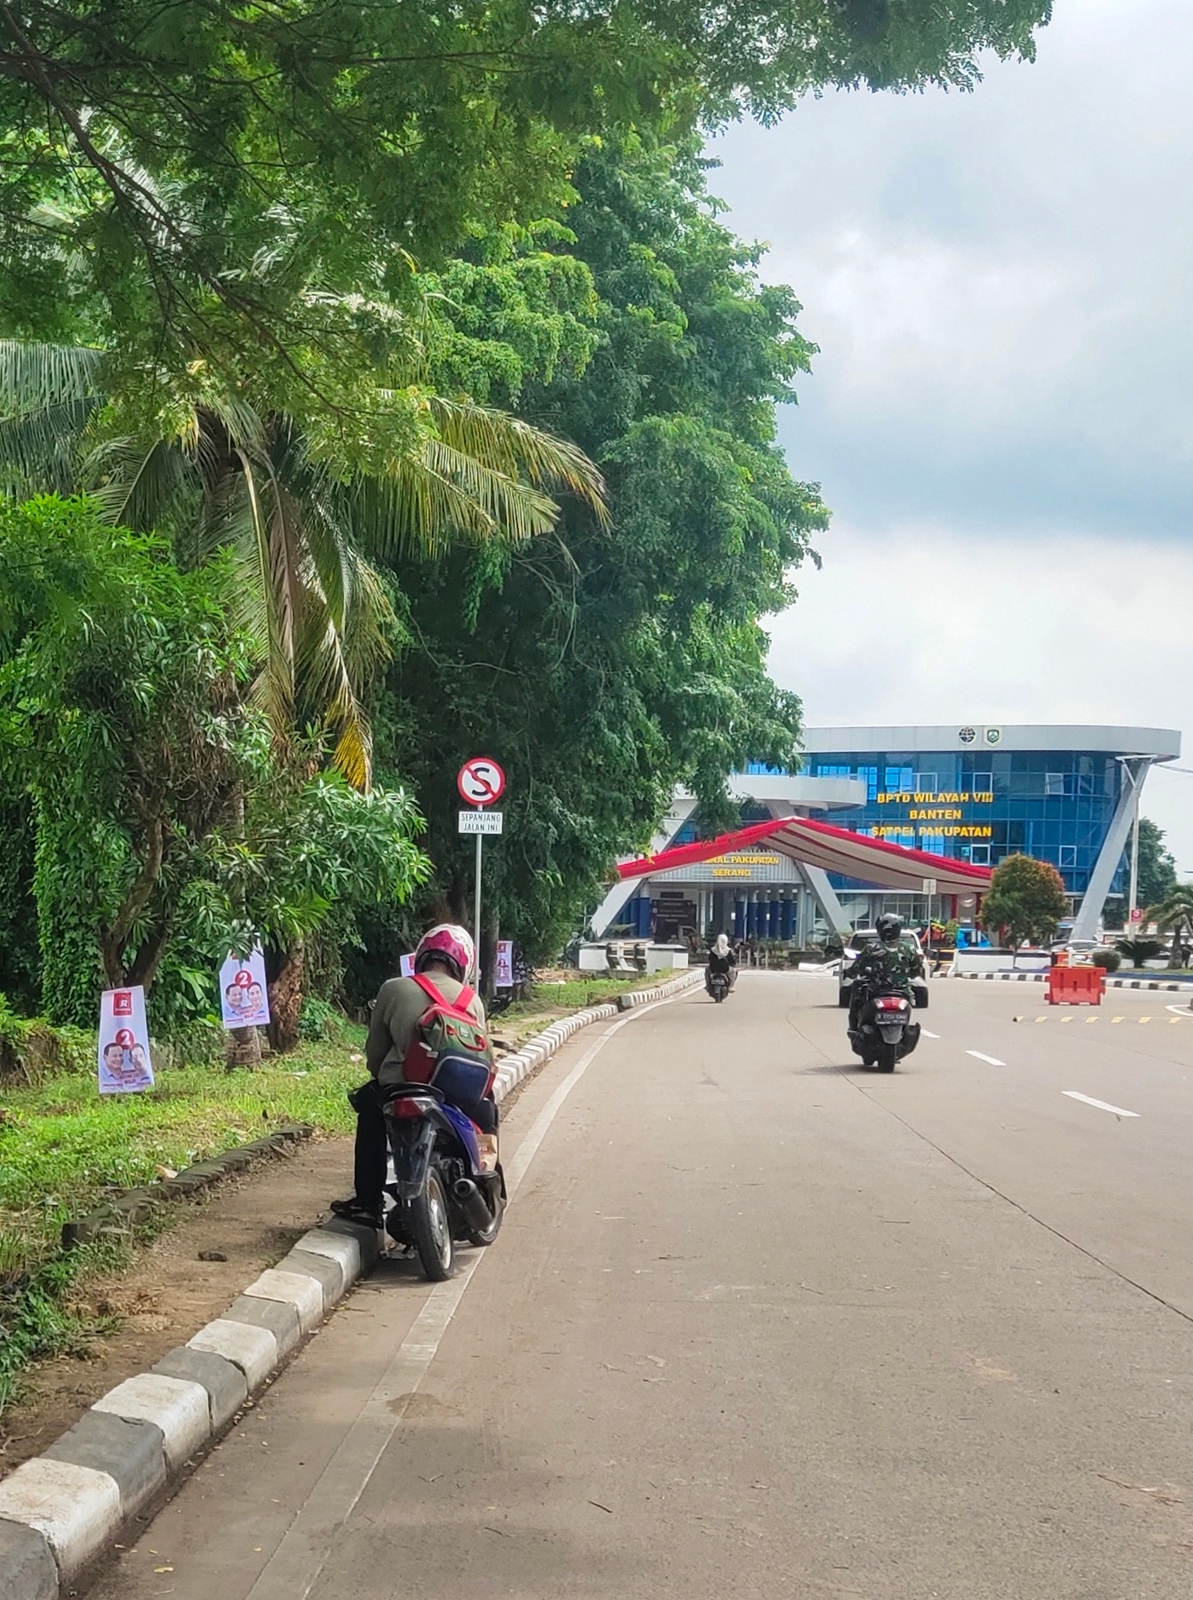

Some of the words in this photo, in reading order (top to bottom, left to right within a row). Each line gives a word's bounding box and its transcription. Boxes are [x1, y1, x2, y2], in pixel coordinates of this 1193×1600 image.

[471, 767, 491, 796] S
[877, 793, 910, 803] BPTD
[913, 793, 969, 803] WILAYAH
[973, 793, 994, 803] VIII
[461, 813, 500, 822] SEPANJANG
[909, 809, 962, 819] BANTEN
[464, 823, 484, 831] JALAN
[488, 824, 498, 832] INI
[871, 827, 915, 837] SATPEL
[919, 827, 992, 837] PAKUPATAN
[238, 972, 249, 986] 2
[120, 1030, 132, 1046] 2
